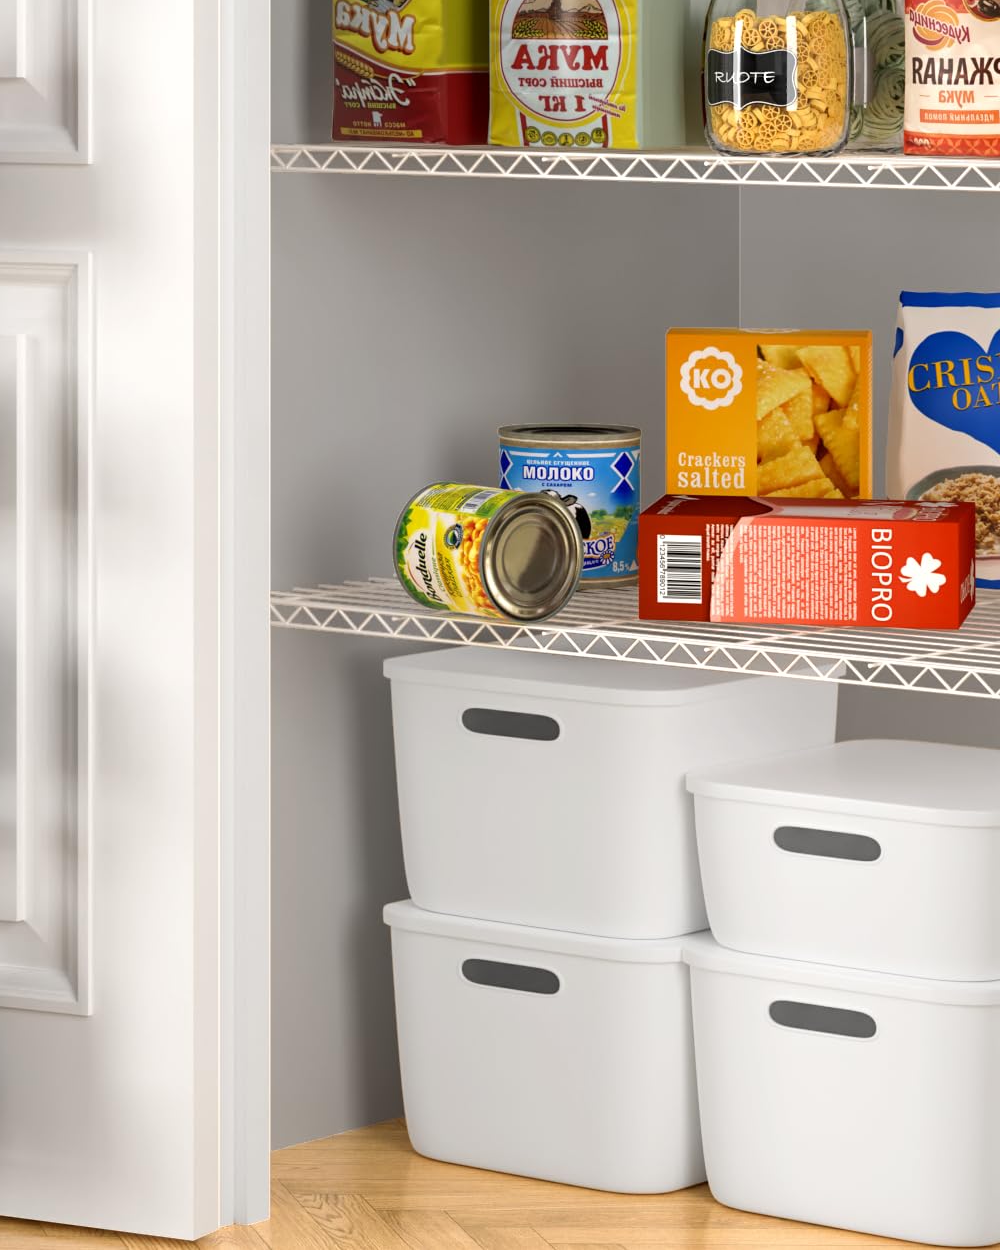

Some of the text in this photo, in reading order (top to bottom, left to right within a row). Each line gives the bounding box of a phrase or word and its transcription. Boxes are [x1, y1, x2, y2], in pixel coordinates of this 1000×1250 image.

[714, 71, 776, 85] RUOTE
[693, 368, 732, 389] KO
[908, 352, 1000, 392] CRIS
[678, 452, 746, 467] Crackers
[522, 466, 594, 481] МОЛОКО
[677, 466, 746, 489] salted
[414, 533, 443, 602] Bonduelle
[870, 528, 893, 622] BIOPRO
